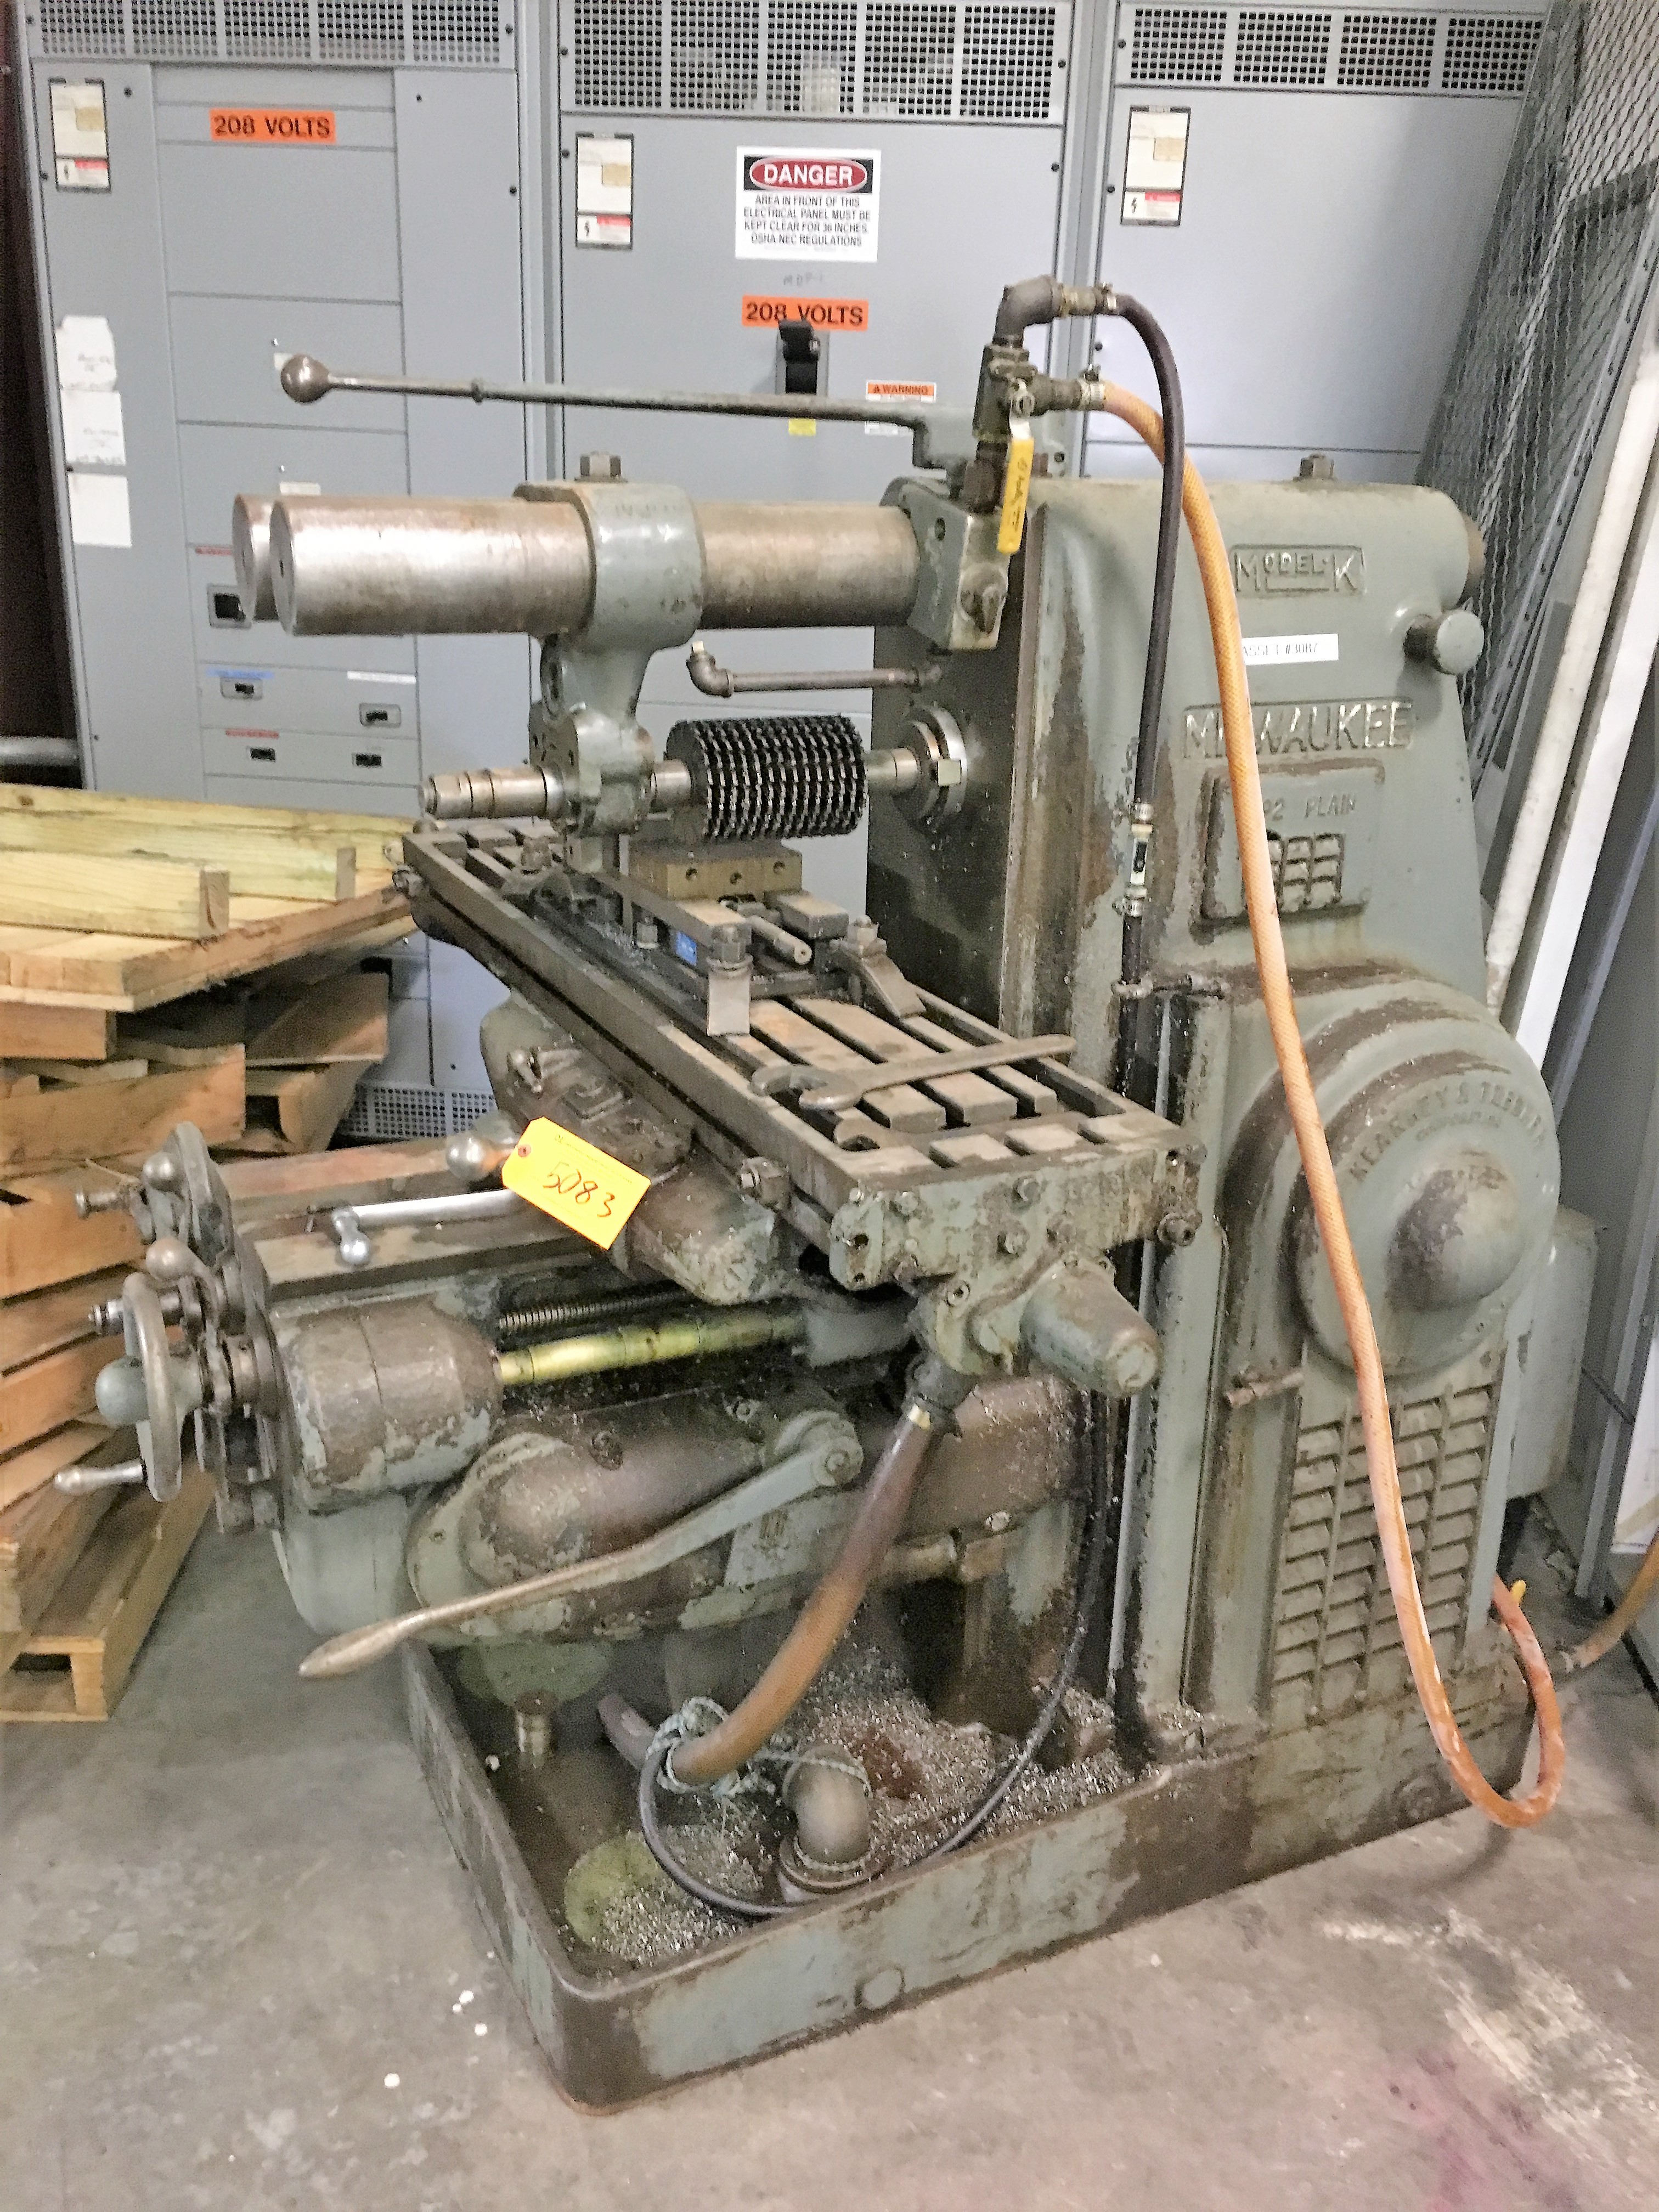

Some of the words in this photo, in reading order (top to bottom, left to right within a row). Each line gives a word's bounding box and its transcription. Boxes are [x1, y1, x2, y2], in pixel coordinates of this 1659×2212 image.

[215, 115, 255, 137] 208
[265, 116, 330, 138] VOLTS
[764, 163, 854, 186] DANGER
[755, 194, 780, 205] AREA
[782, 195, 791, 205] IN
[794, 195, 823, 207] FRONT
[826, 196, 837, 207] OF
[841, 196, 860, 207] THIS
[744, 206, 797, 219] ELECTRICAL
[801, 208, 829, 219] PANEL
[832, 210, 856, 220] MUST
[859, 210, 871, 221] BE
[744, 219, 767, 230] KEPT
[770, 220, 799, 232] CLEAR
[802, 222, 820, 232] FOR
[800, 234, 862, 247] REGULATIONS
[746, 301, 787, 321] 208
[798, 303, 863, 325] VOLTS
[1182, 702, 1413, 758] MIWAUKEE
[1305, 794, 1356, 818] PLAIN
[542, 1161, 615, 1218] 5083
